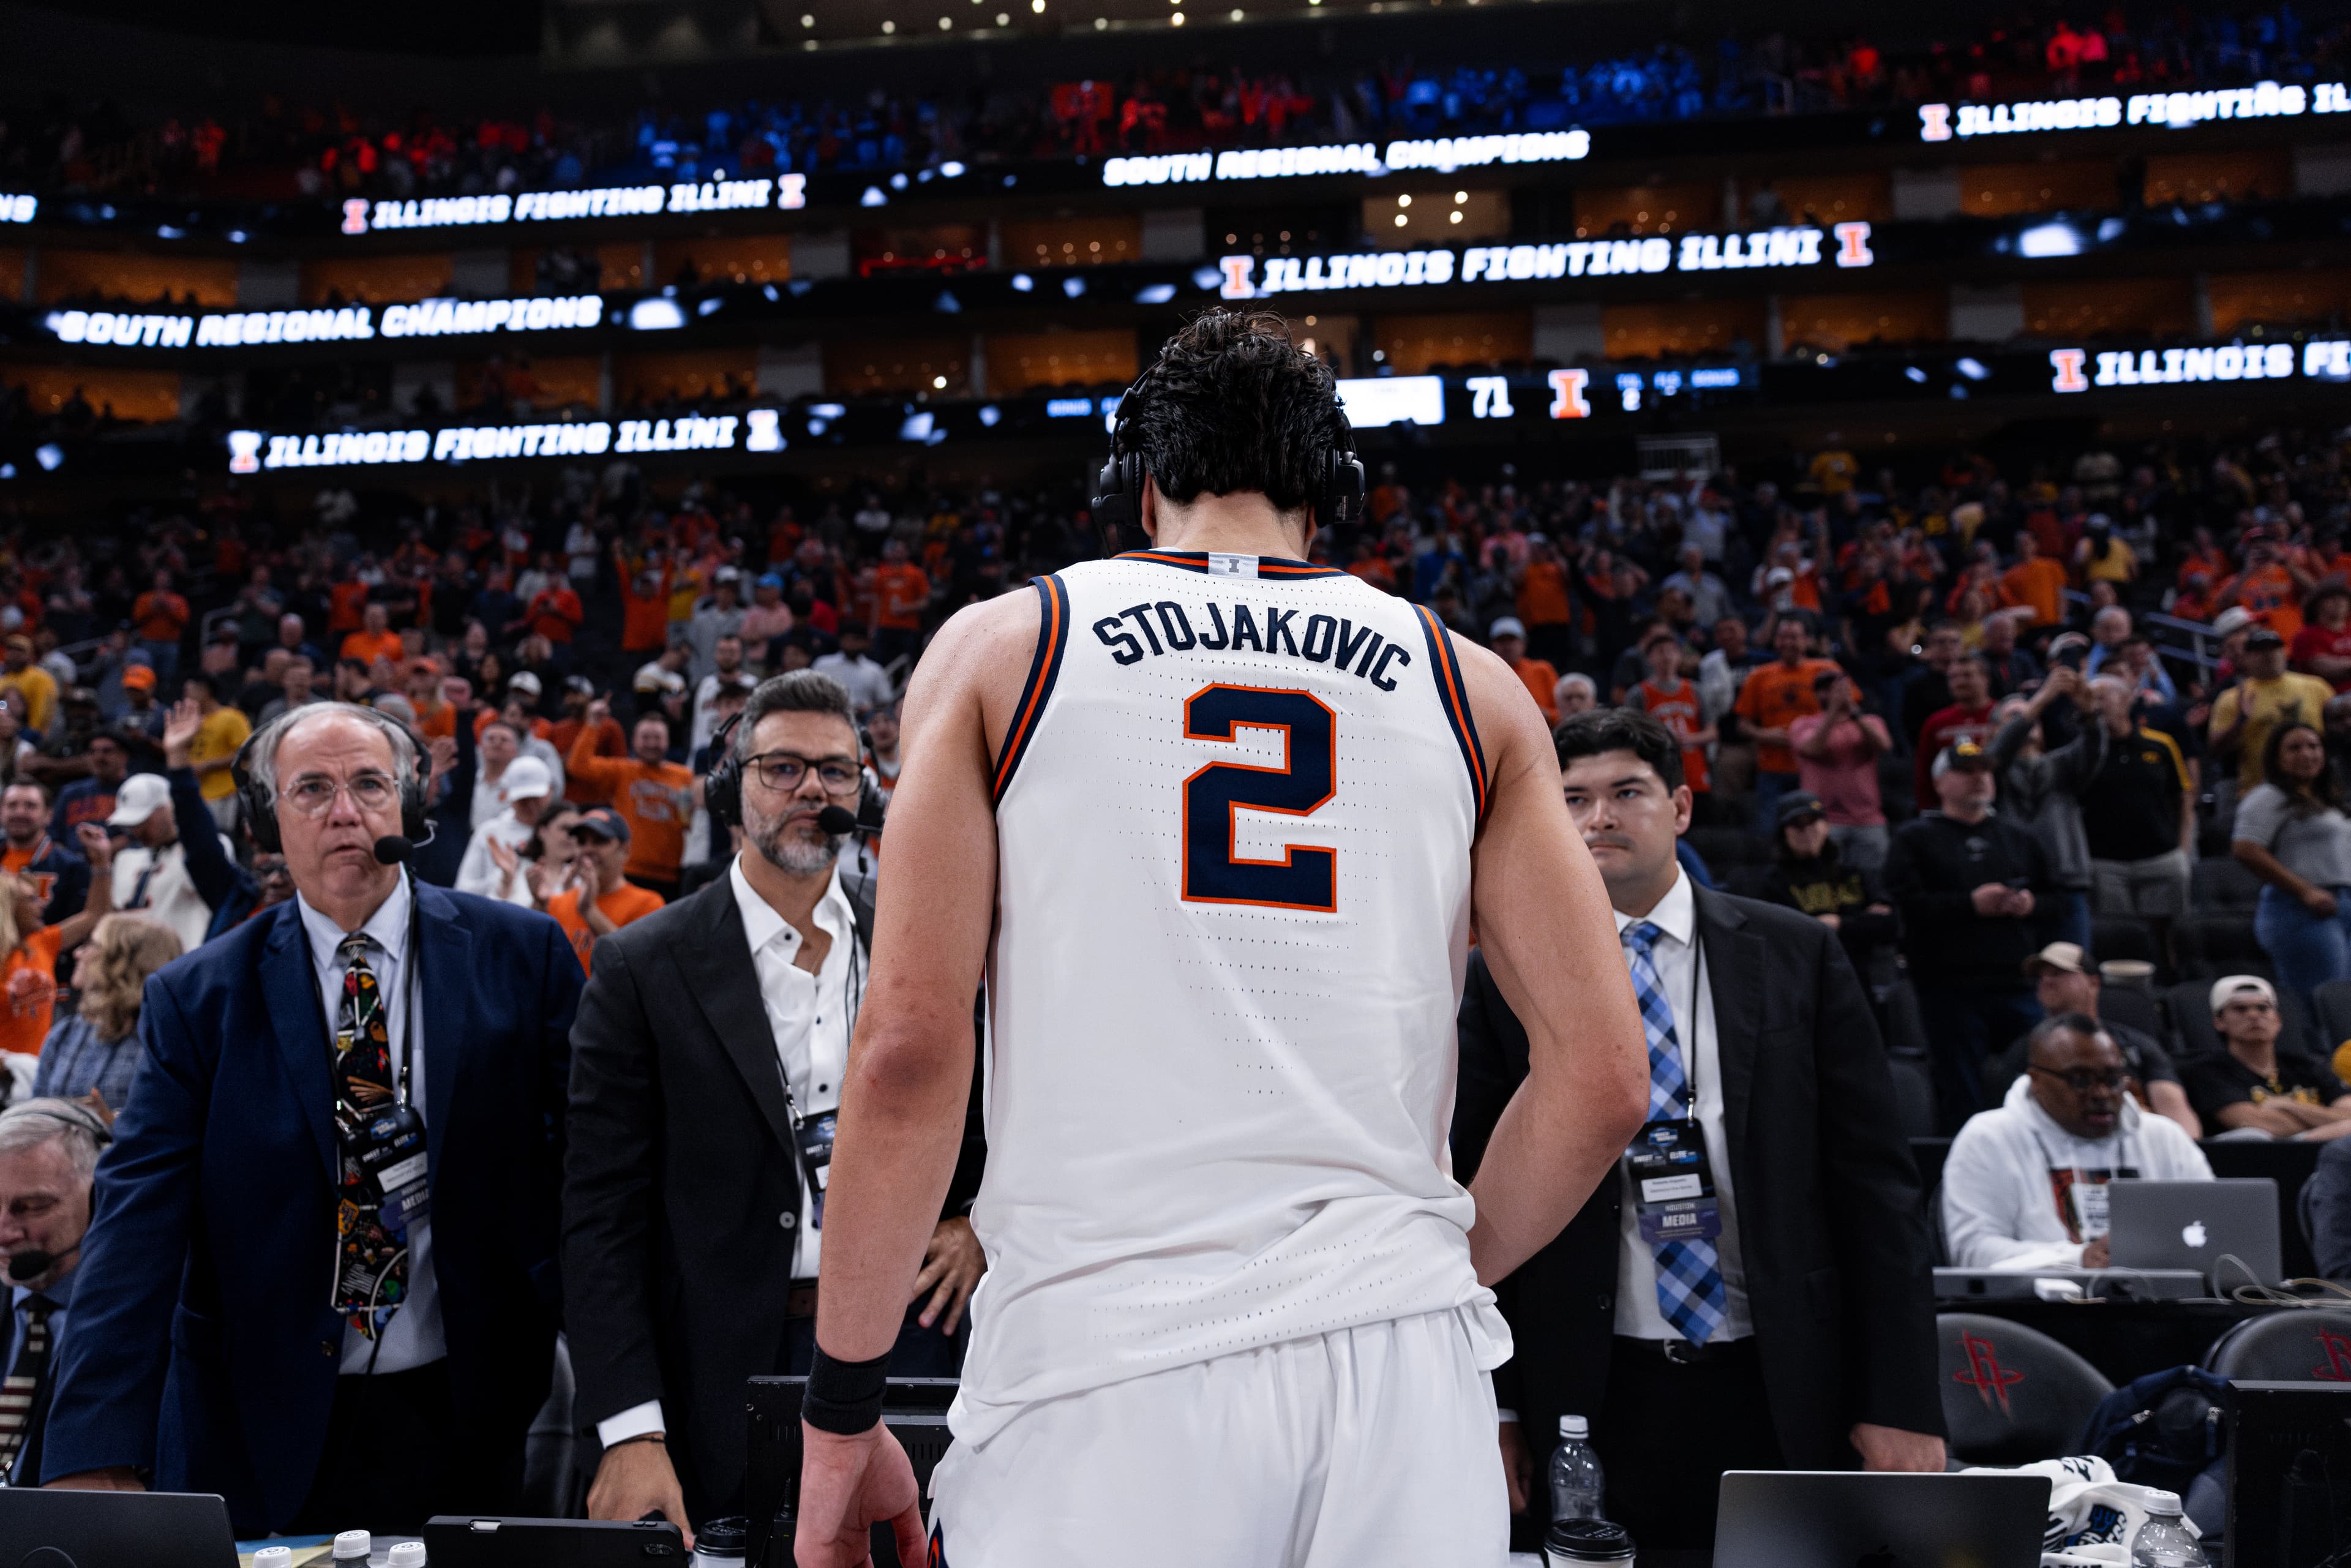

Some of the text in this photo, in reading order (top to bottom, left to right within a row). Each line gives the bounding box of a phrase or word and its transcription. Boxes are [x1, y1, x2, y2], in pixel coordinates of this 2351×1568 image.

[1955, 97, 2121, 134] ILLINOIS
[2127, 84, 2306, 126] FIGHTING
[1103, 130, 1591, 186] SOUTH REGIONAL CHAMPIONS
[372, 195, 512, 228] ILLINOIS
[514, 186, 665, 220] FIGHTING
[667, 179, 772, 212] ILLINI
[1261, 250, 1455, 292] ILLINOIS
[1462, 238, 1671, 282] FIGHTING
[1678, 228, 1823, 271] ILLINI
[58, 295, 602, 347] SOUTH REGIONAL CHAMPIONS
[2094, 343, 2293, 386] ILLINOIS
[1466, 377, 1513, 418] 71
[264, 430, 430, 468] ILLINOIS
[433, 422, 611, 460] FIGHTING
[615, 416, 738, 452] ILLINI
[1092, 601, 1411, 692] STOJAKOVIC
[1182, 683, 1337, 913] 2
[1662, 1213, 1697, 1228] MEDIA
